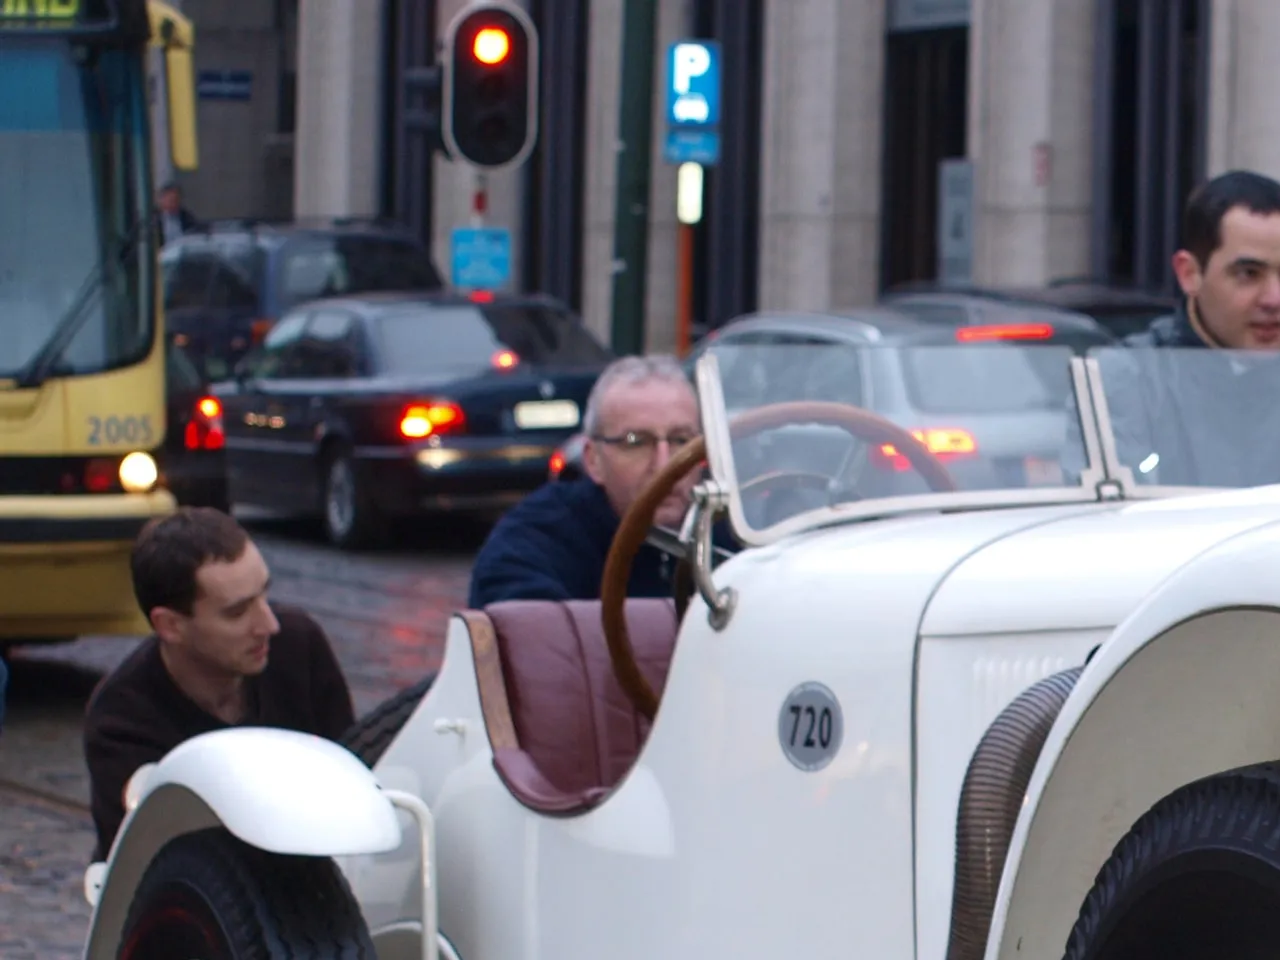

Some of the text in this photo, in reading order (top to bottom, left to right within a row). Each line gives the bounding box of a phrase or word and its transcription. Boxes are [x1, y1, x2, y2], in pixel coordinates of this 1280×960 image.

[673, 43, 711, 94] P
[86, 414, 154, 446] 2005
[789, 704, 832, 749] 720
